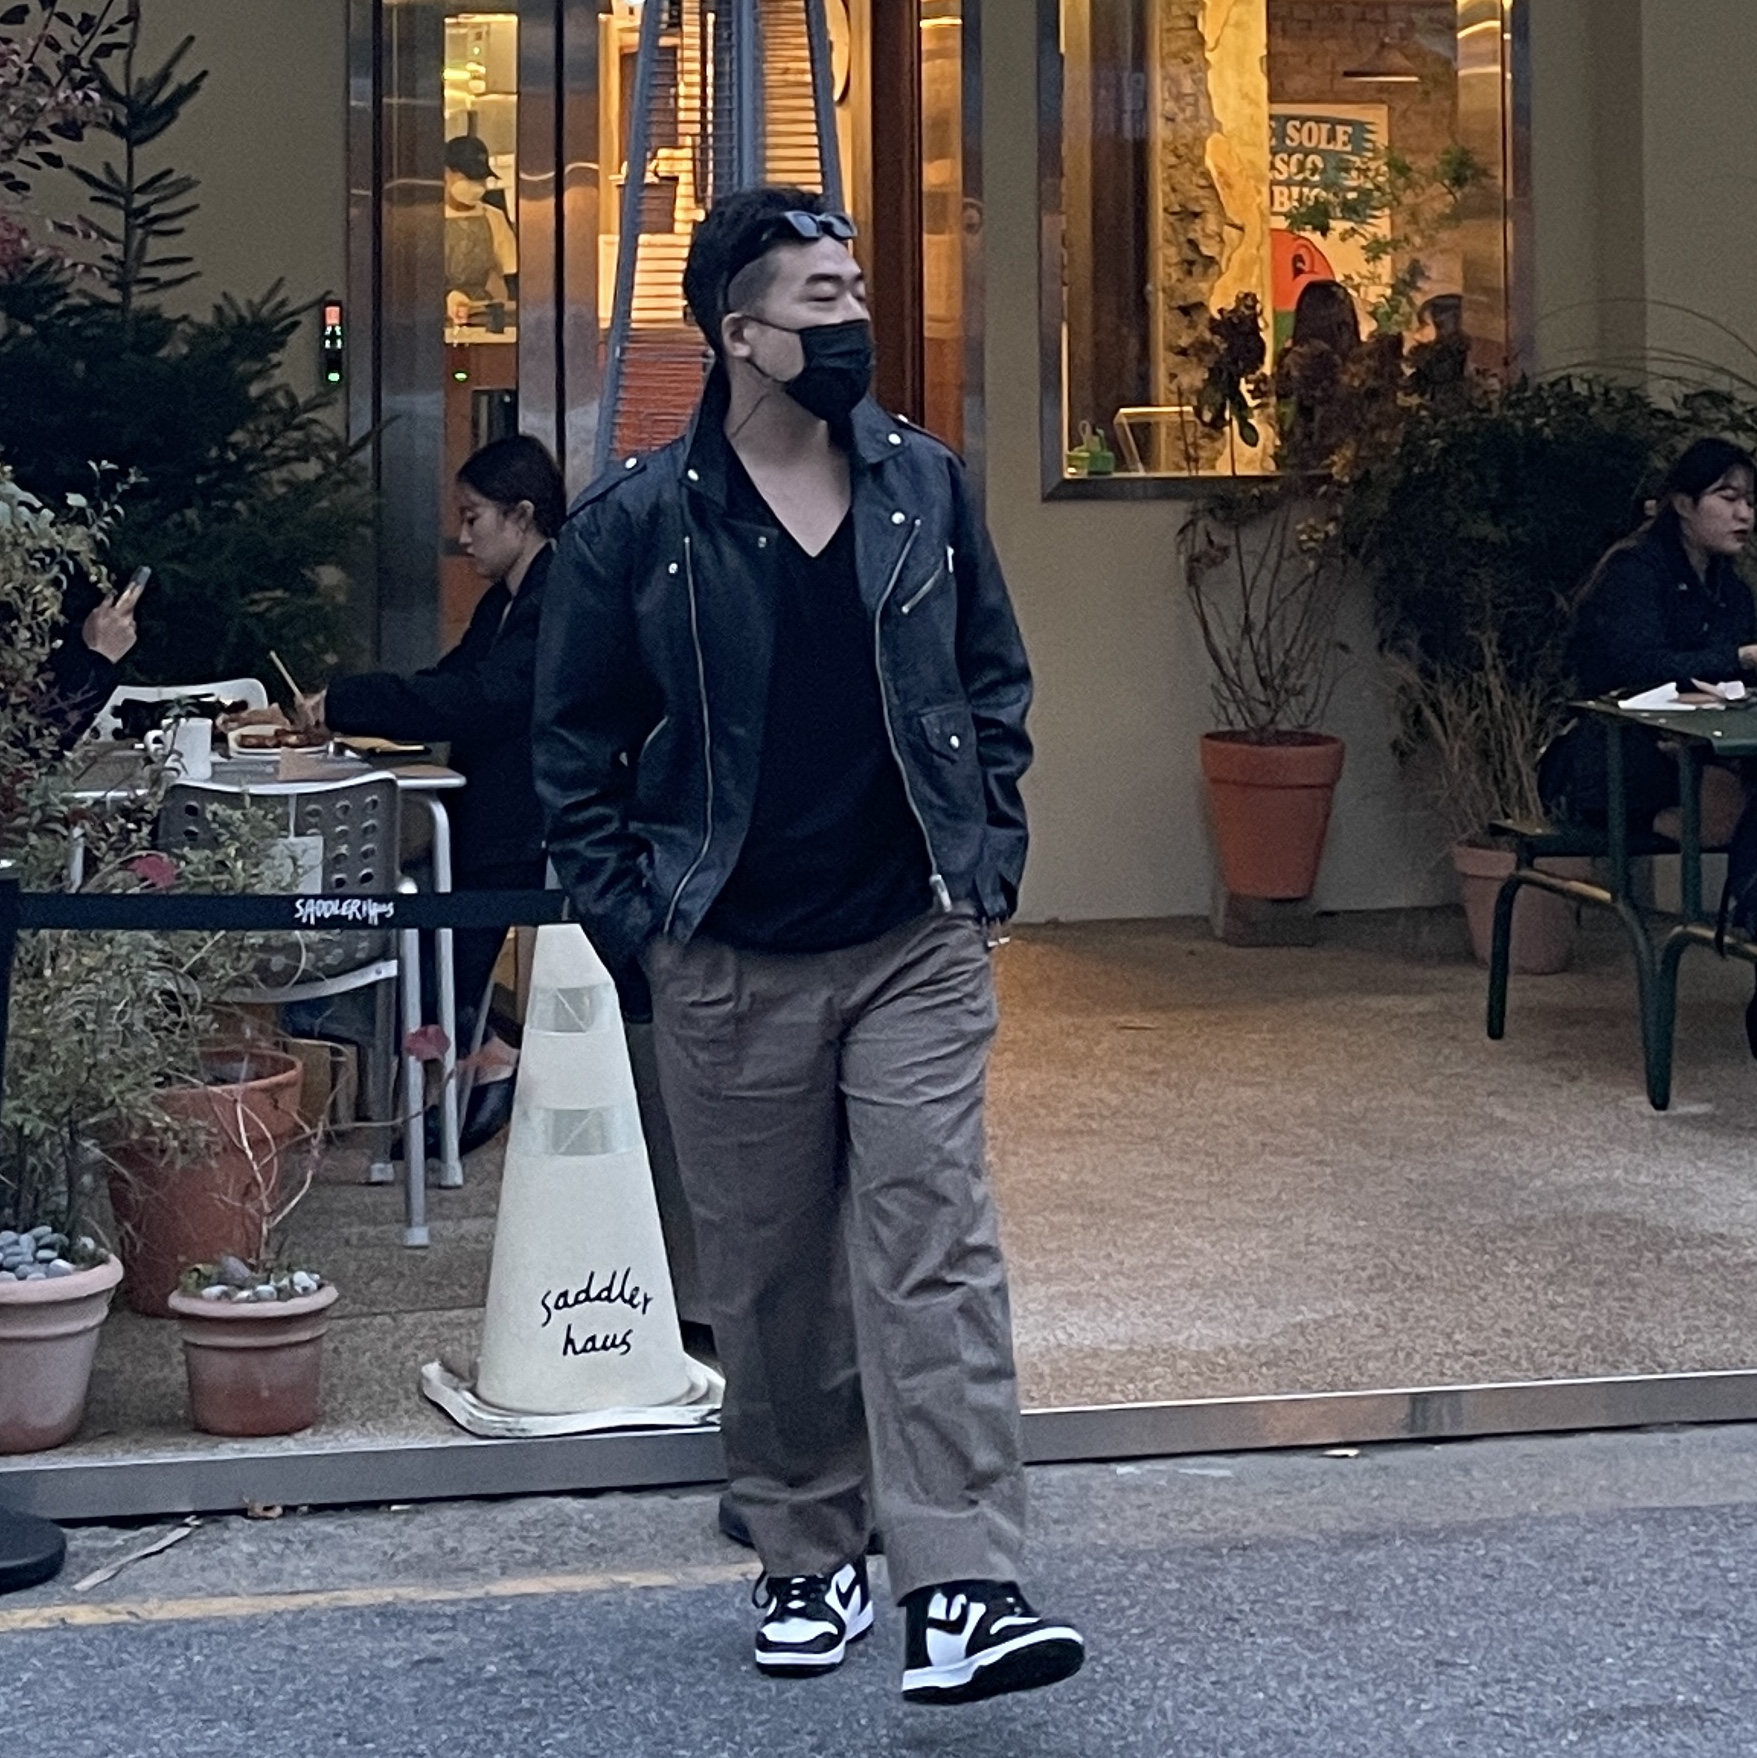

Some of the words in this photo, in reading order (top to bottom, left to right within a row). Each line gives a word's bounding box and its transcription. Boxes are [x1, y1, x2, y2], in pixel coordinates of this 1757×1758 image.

[1285, 120, 1353, 152] SOLE
[1270, 153, 1325, 181] SCO
[540, 1266, 653, 1328] saddler
[562, 1322, 634, 1357] haus
